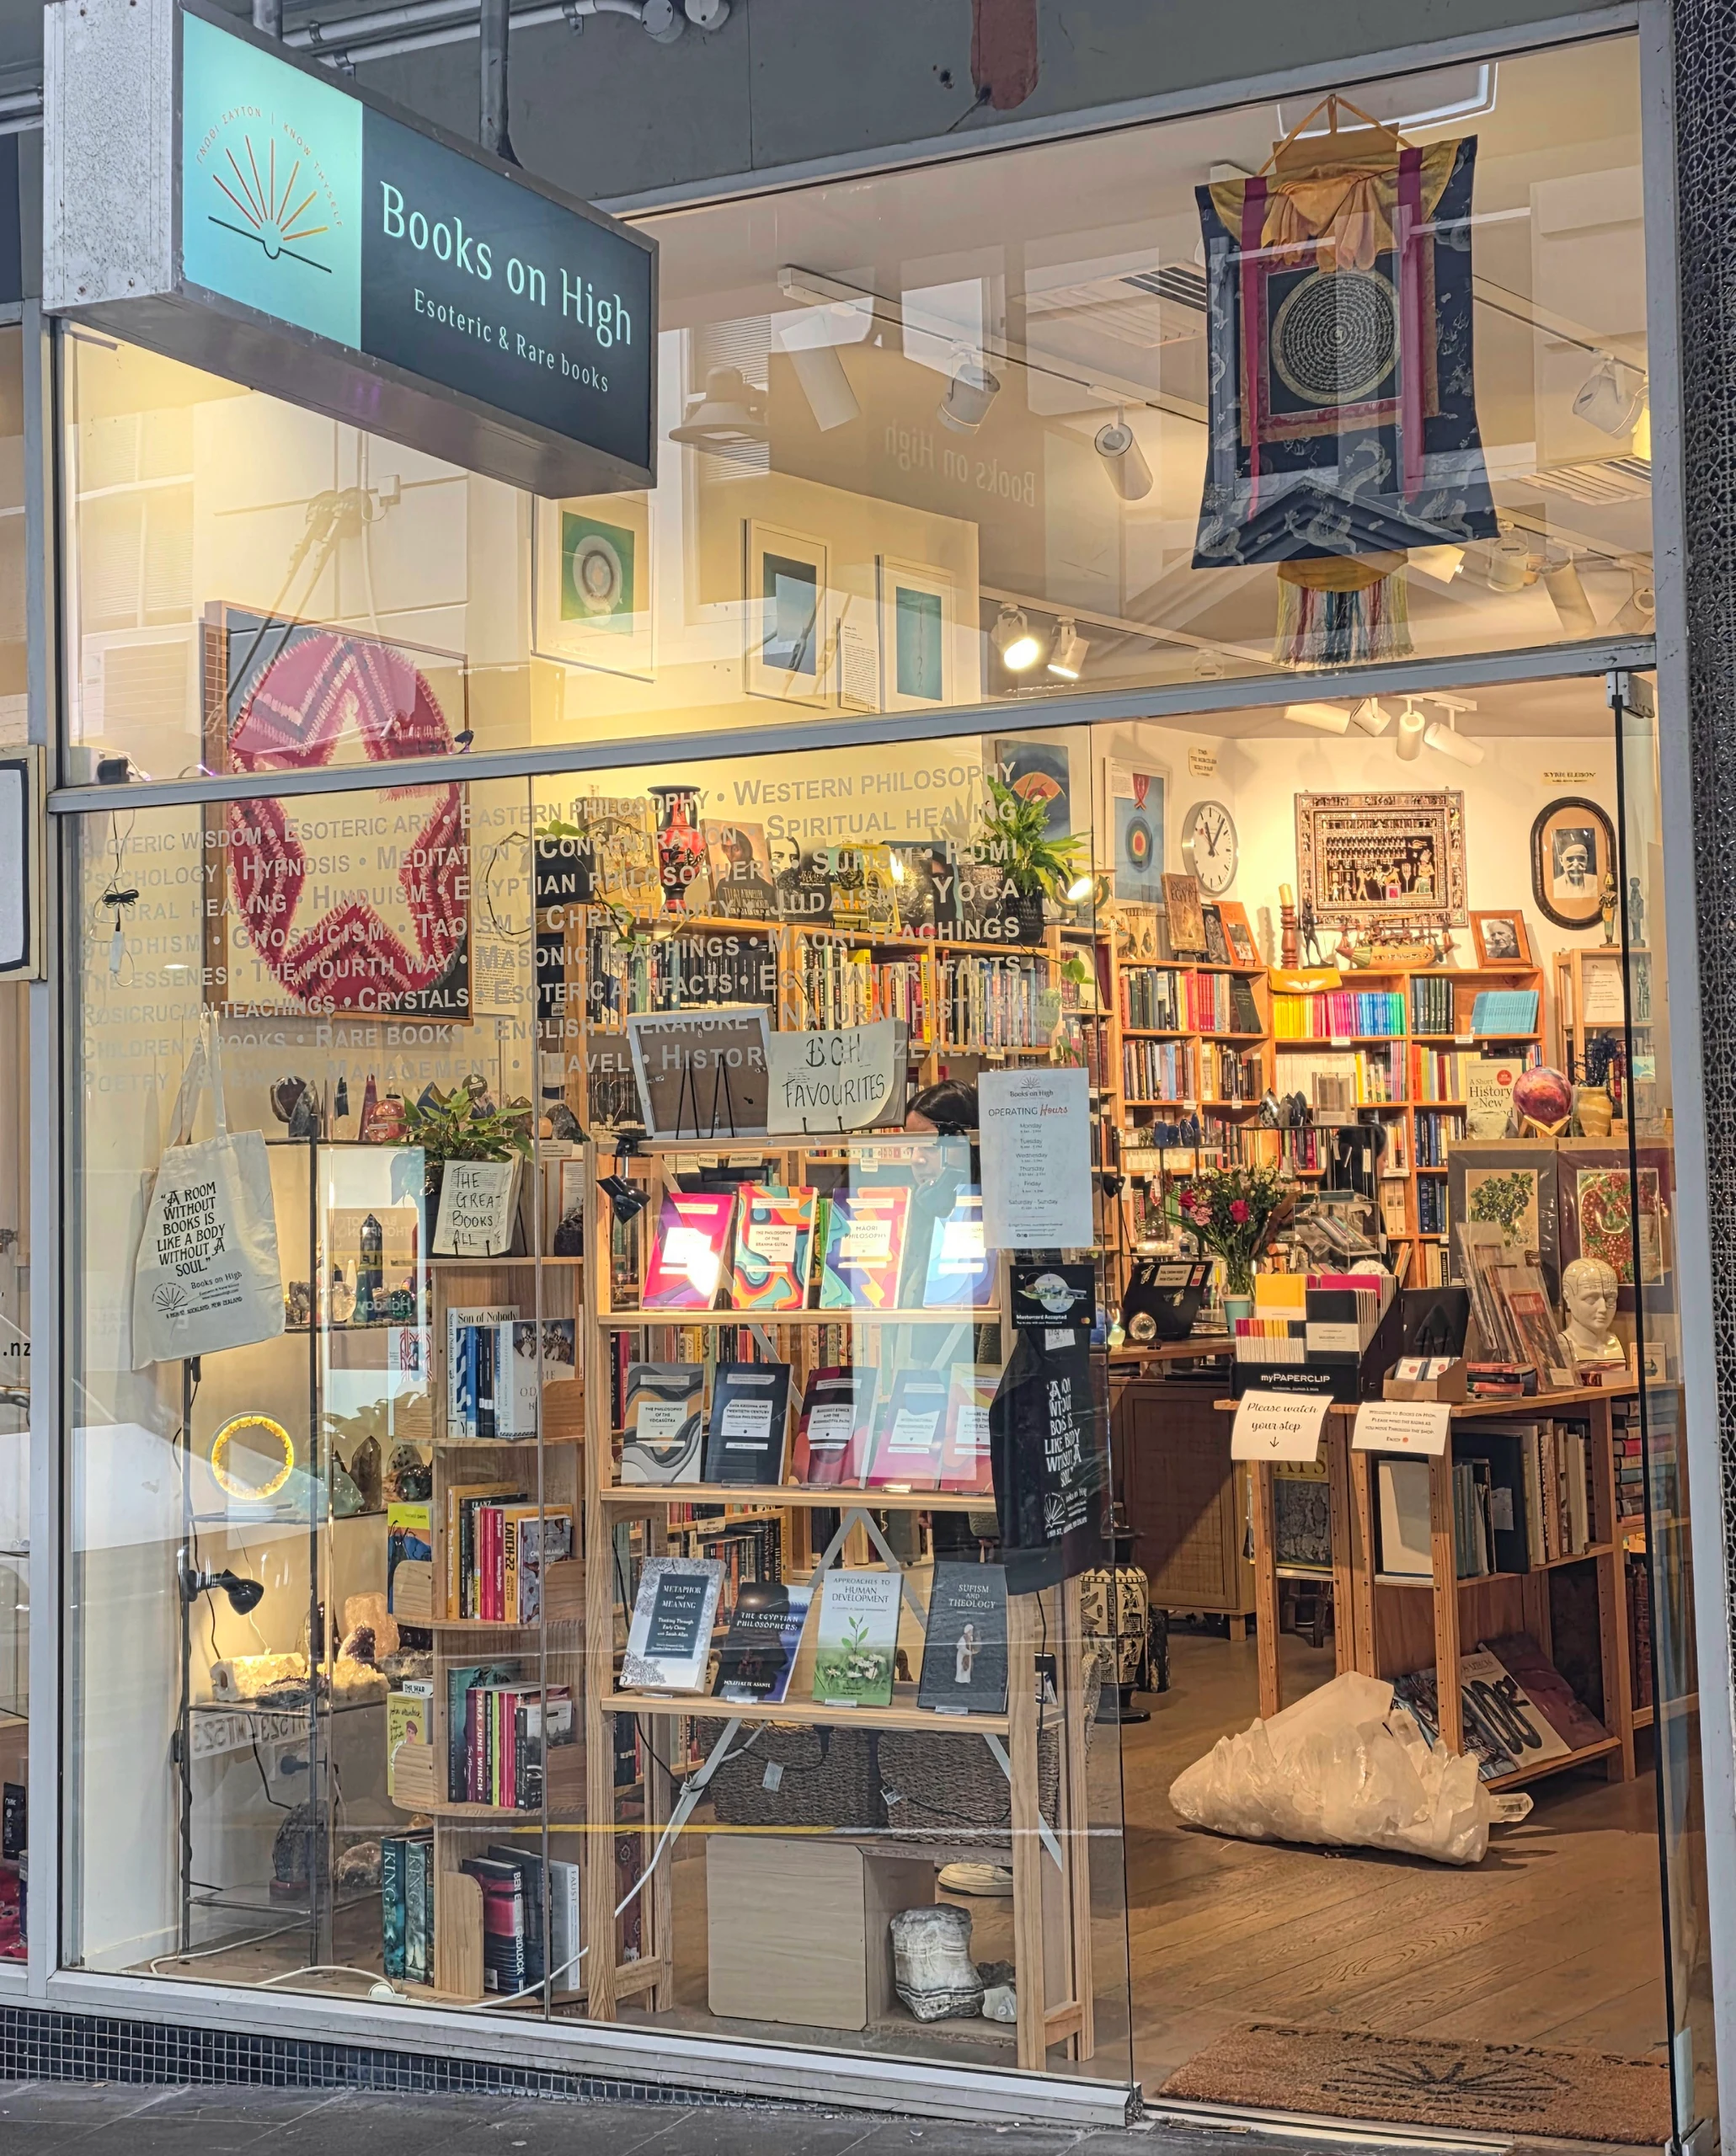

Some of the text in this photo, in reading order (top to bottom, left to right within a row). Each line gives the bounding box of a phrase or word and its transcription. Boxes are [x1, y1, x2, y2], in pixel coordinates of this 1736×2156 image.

[282, 121, 343, 227] KNOW THYSELF
[380, 180, 633, 348] Books on High
[413, 287, 610, 393] Esoteric & Rare books
[180, 760, 1017, 851] WISDOM ESOTERIC ART EASTERN PHILOSOPHY WESTERN PHILOSOPHY
[242, 854, 350, 881] HYPNOSIS
[377, 841, 510, 869] MEDITATION
[538, 825, 737, 859] CONCENTRATION
[767, 810, 896, 841] SPIRITUAL
[905, 800, 1017, 830] HEALING
[191, 893, 287, 918] HEALING
[312, 884, 428, 910] HINDUISM
[455, 873, 576, 900] EGYPTIAN
[588, 857, 781, 891] PHILOSOPHERS
[811, 846, 914, 875] SUFISM
[945, 839, 1018, 865] RUMI
[1171, 889, 1198, 904] EGYPT
[232, 921, 384, 950] GNOSTICISM
[417, 912, 512, 938] TAOISM
[547, 899, 734, 931] CHRISTIANITY
[770, 888, 895, 916] JUDAISM
[932, 876, 1020, 905] YOGA
[133, 966, 227, 989] ESSENES
[251, 958, 296, 983] THE
[306, 955, 394, 981] FOURTH
[404, 953, 452, 975] WAY
[478, 944, 589, 970] MASONIC
[767, 926, 855, 953] MAORI
[868, 916, 1020, 947] TEACHINGS
[82, 1001, 215, 1028] ROSICRUCIAN
[220, 995, 336, 1019] TEACHINGS
[358, 986, 469, 1011] CRYSTALS
[494, 978, 606, 1006] ESOTERIC
[759, 963, 882, 990] EGYPTIAN
[887, 956, 1022, 984] ARTIFACTS
[316, 1024, 384, 1049] RARE
[387, 1024, 463, 1046] BOOKS
[494, 1015, 595, 1041] ENGLISH
[916, 994, 1022, 1021] HISTORY
[82, 1070, 168, 1093] POETRY
[327, 1056, 499, 1081] MANAGEMENT
[661, 1043, 773, 1070] HISTORY
[782, 1074, 886, 1108] FAVOURITES
[1010, 1090, 1028, 1098] Books
[1039, 1090, 1054, 1098] High
[1469, 1086, 1513, 1099] History
[988, 1105, 1068, 1118] OPERATING Hours
[1479, 1097, 1504, 1108] New
[452, 1164, 482, 1190] THE
[1023, 1180, 1042, 1188] Friday
[184, 1181, 216, 1202] ROOM
[1008, 1198, 1059, 1206] Saturday Sunday
[163, 1196, 216, 1221] WITHOUT
[163, 1211, 215, 1236] BOOKS IS
[451, 1209, 494, 1230] BOOKS
[157, 1224, 226, 1252] LIKE A BODY
[451, 1230, 478, 1247] ALL
[158, 1236, 226, 1267] WITHOUT A
[190, 1278, 213, 1290] Books
[225, 1271, 243, 1281] High
[457, 1310, 517, 1324] Son of Nobody
[1260, 1372, 1331, 1384] myPAPERCLIP
[1247, 1401, 1318, 1414] Please watch
[1251, 1419, 1302, 1433] your step
[505, 1521, 515, 1572] CATCH-22
[662, 1584, 702, 1594] METAPHOR
[831, 1593, 889, 1604] DEVELOPMENT
[845, 1586, 878, 1594] HUMAN
[958, 1584, 990, 1594] SUFISM
[662, 1600, 697, 1609] MEANING
[948, 1598, 997, 1609] THEOLOGY
[741, 1611, 799, 1623] THE EGYPTIAN
[384, 1849, 396, 1904] KING
[408, 1853, 420, 1907] KING
[513, 1871, 521, 1892] BEN
